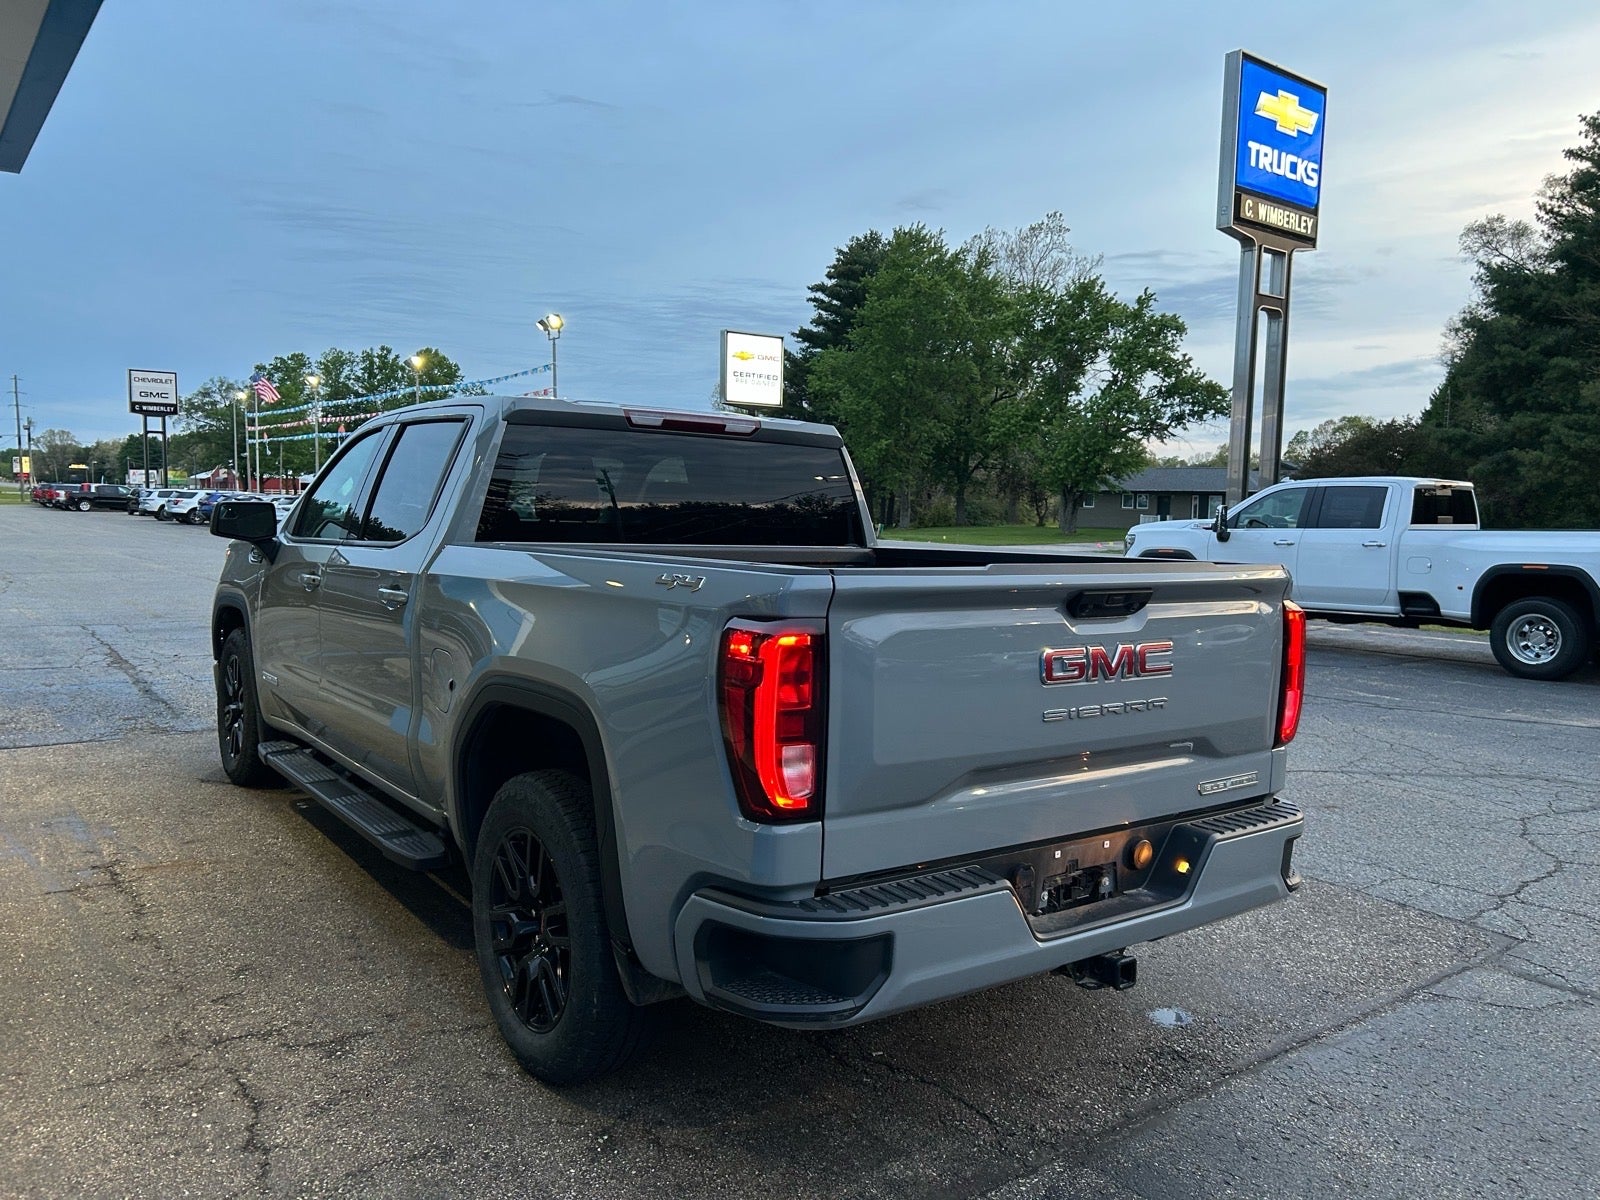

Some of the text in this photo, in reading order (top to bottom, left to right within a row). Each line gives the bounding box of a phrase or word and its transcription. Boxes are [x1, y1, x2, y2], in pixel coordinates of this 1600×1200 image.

[1247, 140, 1319, 188] TRUCKS
[1245, 199, 1314, 235] C. WIMBERLEY
[757, 354, 780, 362] GMC
[133, 376, 174, 384] CHEVROLET
[732, 370, 779, 381] CERTIFIED
[139, 391, 169, 399] GMC
[1041, 640, 1174, 686] GMC
[1042, 697, 1168, 722] SIERRA
